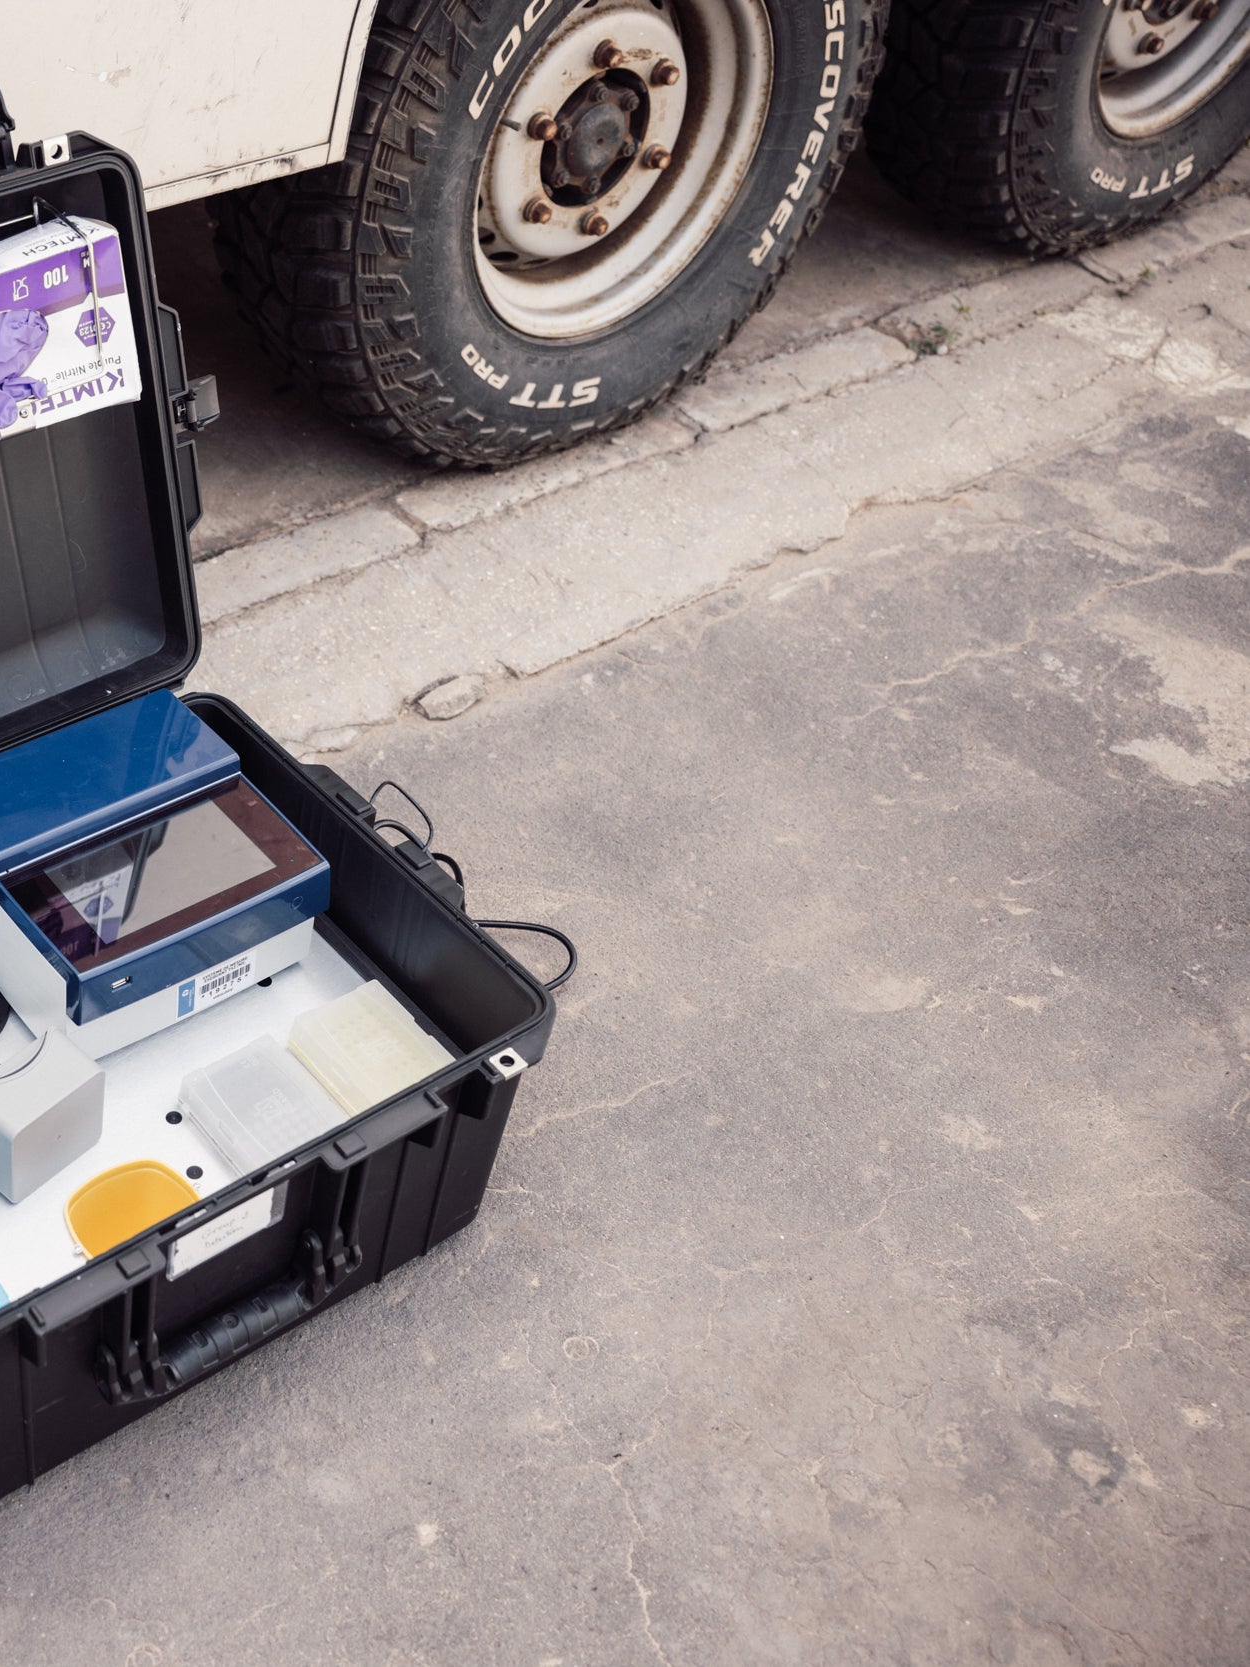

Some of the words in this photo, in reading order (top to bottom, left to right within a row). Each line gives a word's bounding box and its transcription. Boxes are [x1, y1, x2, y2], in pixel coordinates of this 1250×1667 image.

[748, 0, 846, 267] SCOVERER
[1090, 166, 1128, 193] PRO
[1129, 154, 1195, 199] STT
[22, 227, 100, 257] KMTECH
[43, 264, 70, 289] 100
[461, 343, 511, 390] PRO
[509, 376, 601, 409] STT
